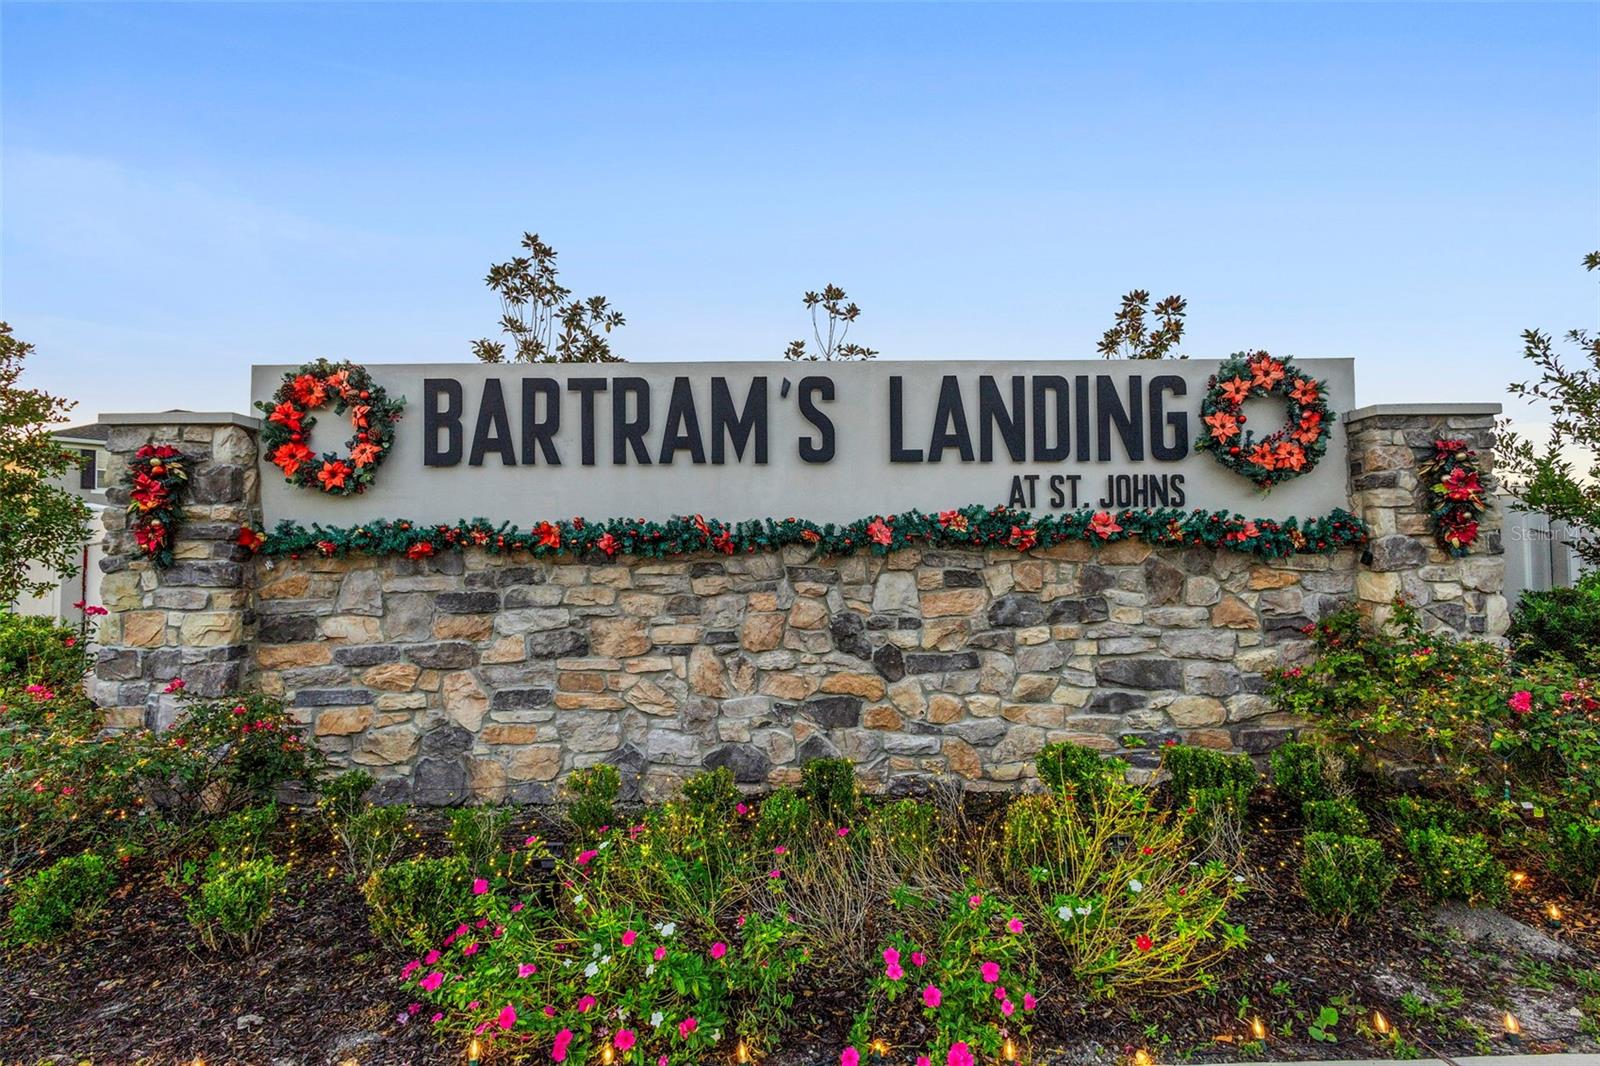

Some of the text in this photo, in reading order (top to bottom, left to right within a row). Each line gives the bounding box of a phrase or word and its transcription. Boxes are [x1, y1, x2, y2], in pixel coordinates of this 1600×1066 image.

[423, 375, 1188, 466] BARTRAM'S LANDING
[1009, 474, 1185, 508] AT ST. JOHNS
